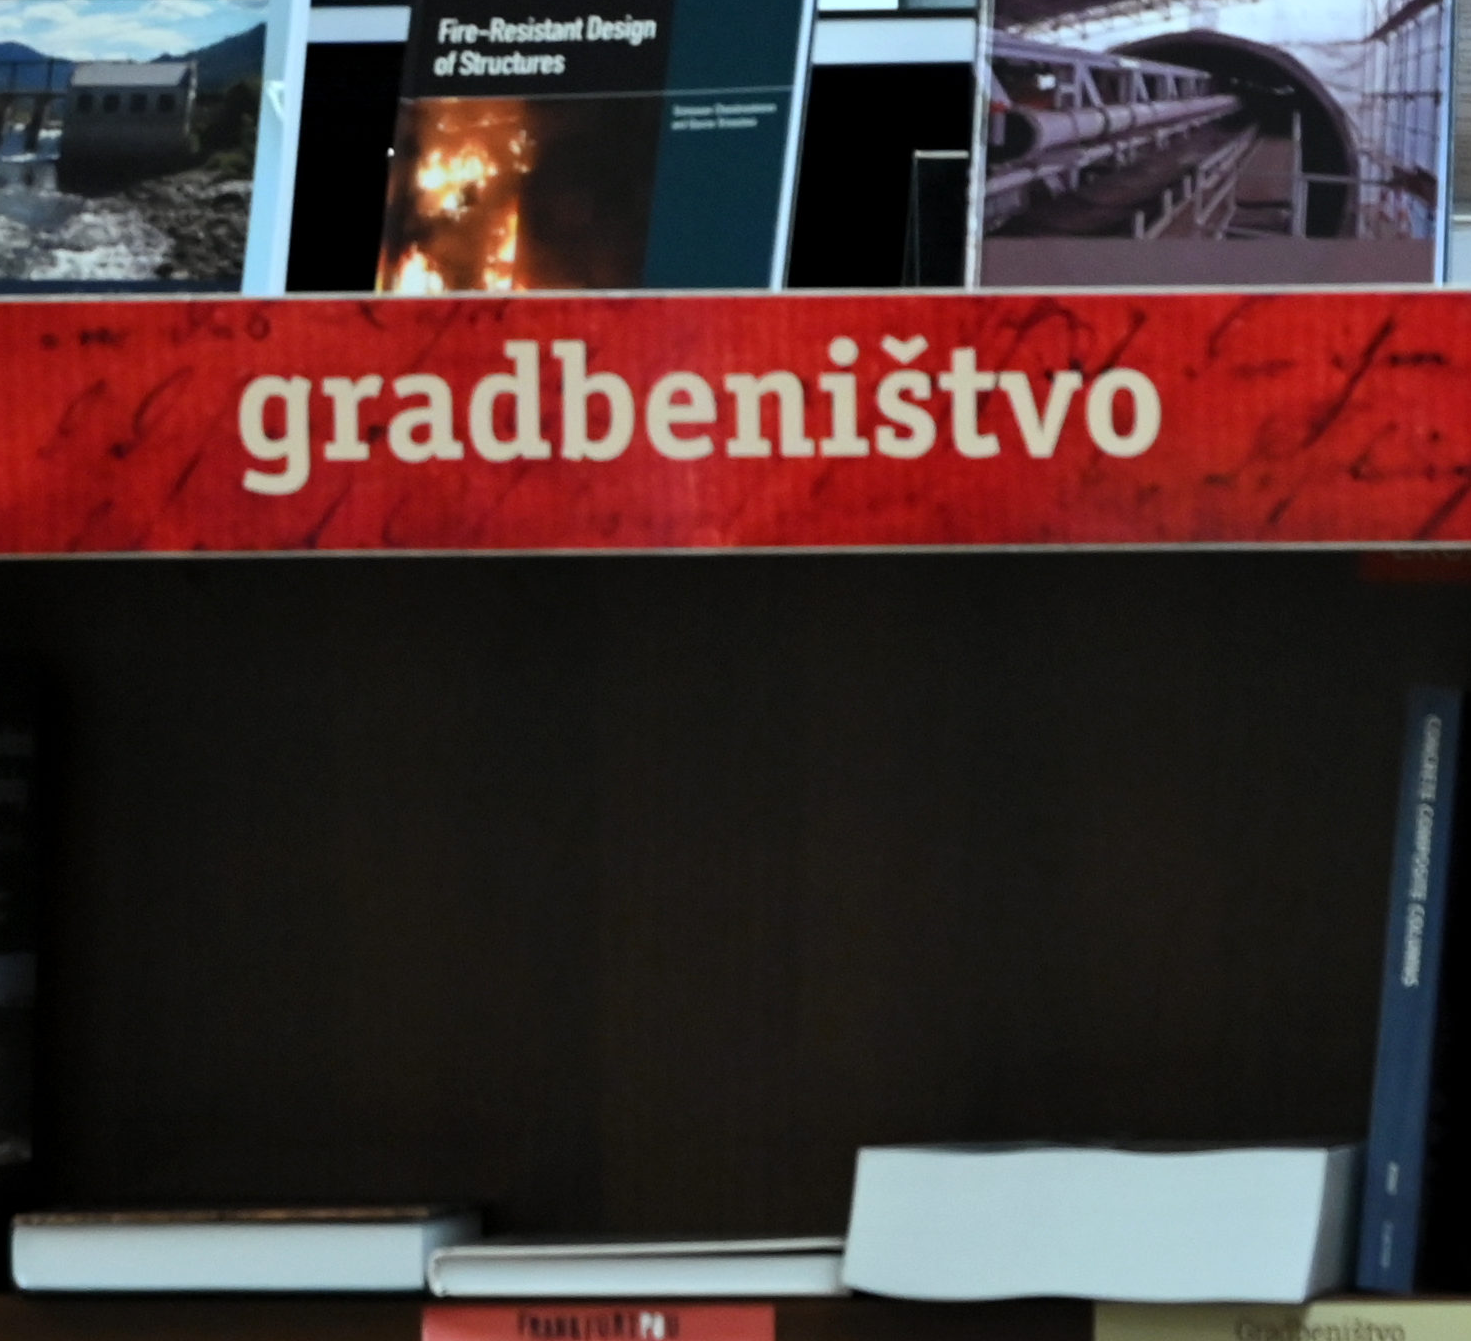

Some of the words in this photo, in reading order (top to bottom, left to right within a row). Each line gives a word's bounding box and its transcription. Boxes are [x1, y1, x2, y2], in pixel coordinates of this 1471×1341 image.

[434, 51, 456, 76] of
[459, 50, 566, 76] Structures
[438, 16, 583, 45] Fire-Resistant
[586, 14, 657, 46] Design
[238, 334, 1162, 495] gradbeništvo
[1418, 713, 1443, 802] CONCRETE
[1409, 802, 1435, 902] COMPOSITE
[1400, 902, 1426, 988] COLUMNS
